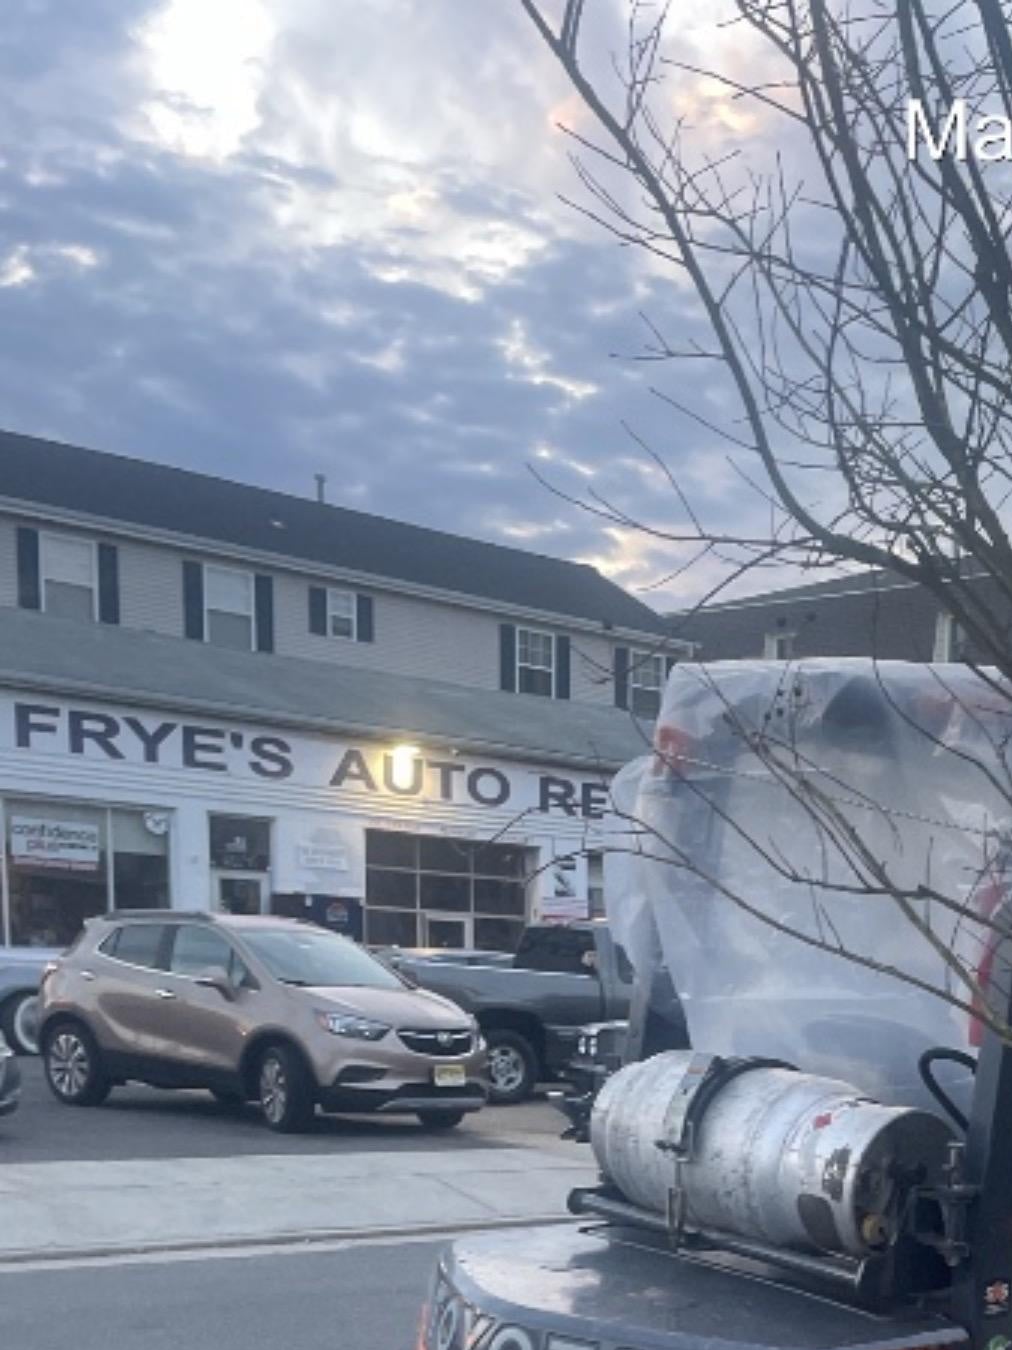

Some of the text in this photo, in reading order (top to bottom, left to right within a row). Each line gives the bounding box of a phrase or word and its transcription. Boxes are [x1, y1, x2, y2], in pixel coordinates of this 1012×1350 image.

[14, 702, 609, 819] FRYE'S AUTO RE
